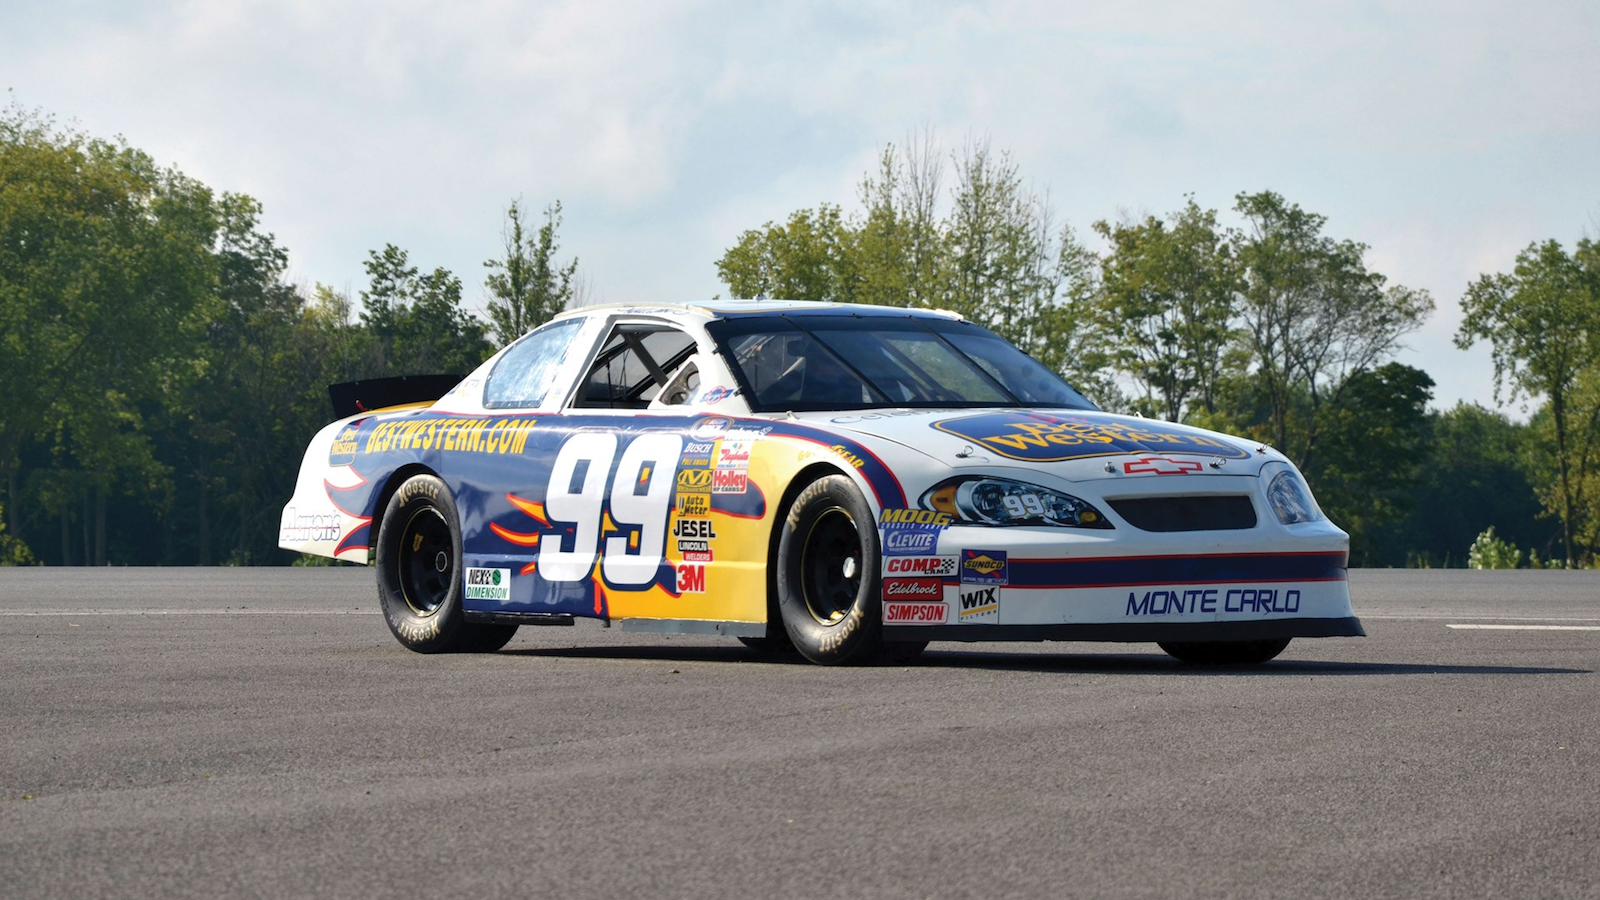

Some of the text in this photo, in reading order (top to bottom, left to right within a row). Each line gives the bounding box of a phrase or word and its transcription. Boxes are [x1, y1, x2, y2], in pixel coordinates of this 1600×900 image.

[341, 428, 360, 442] Best
[365, 419, 537, 454] BESTWESTERN.COM
[1004, 421, 1148, 440] Best
[332, 441, 357, 455] Western
[683, 443, 713, 453] BUSCH
[981, 430, 1225, 451] Western
[713, 471, 746, 492] Holley
[400, 481, 440, 508] Hoosier
[686, 496, 704, 505] Auto
[538, 433, 683, 584] 99
[684, 505, 708, 515] Meter
[787, 479, 829, 533] Hoosier
[1002, 495, 1045, 518] 99
[281, 507, 342, 542] Aaron's
[879, 509, 952, 526] MOOG
[673, 520, 716, 538] JESEL
[679, 541, 708, 551] LINCOLN
[685, 552, 711, 561] WELDERS
[887, 558, 941, 573] COMP
[965, 560, 1003, 569] SUNOCO
[677, 564, 705, 592] 3M
[466, 586, 508, 599] DIMENSION
[887, 582, 937, 595] Edelbrock
[960, 587, 997, 610] WIX
[1126, 589, 1300, 616] MONTE CARLO
[887, 605, 945, 621] SIMPSON
[960, 609, 998, 621] FILTERS
[397, 615, 440, 642] Hoosier
[819, 599, 865, 652] Hoosier
